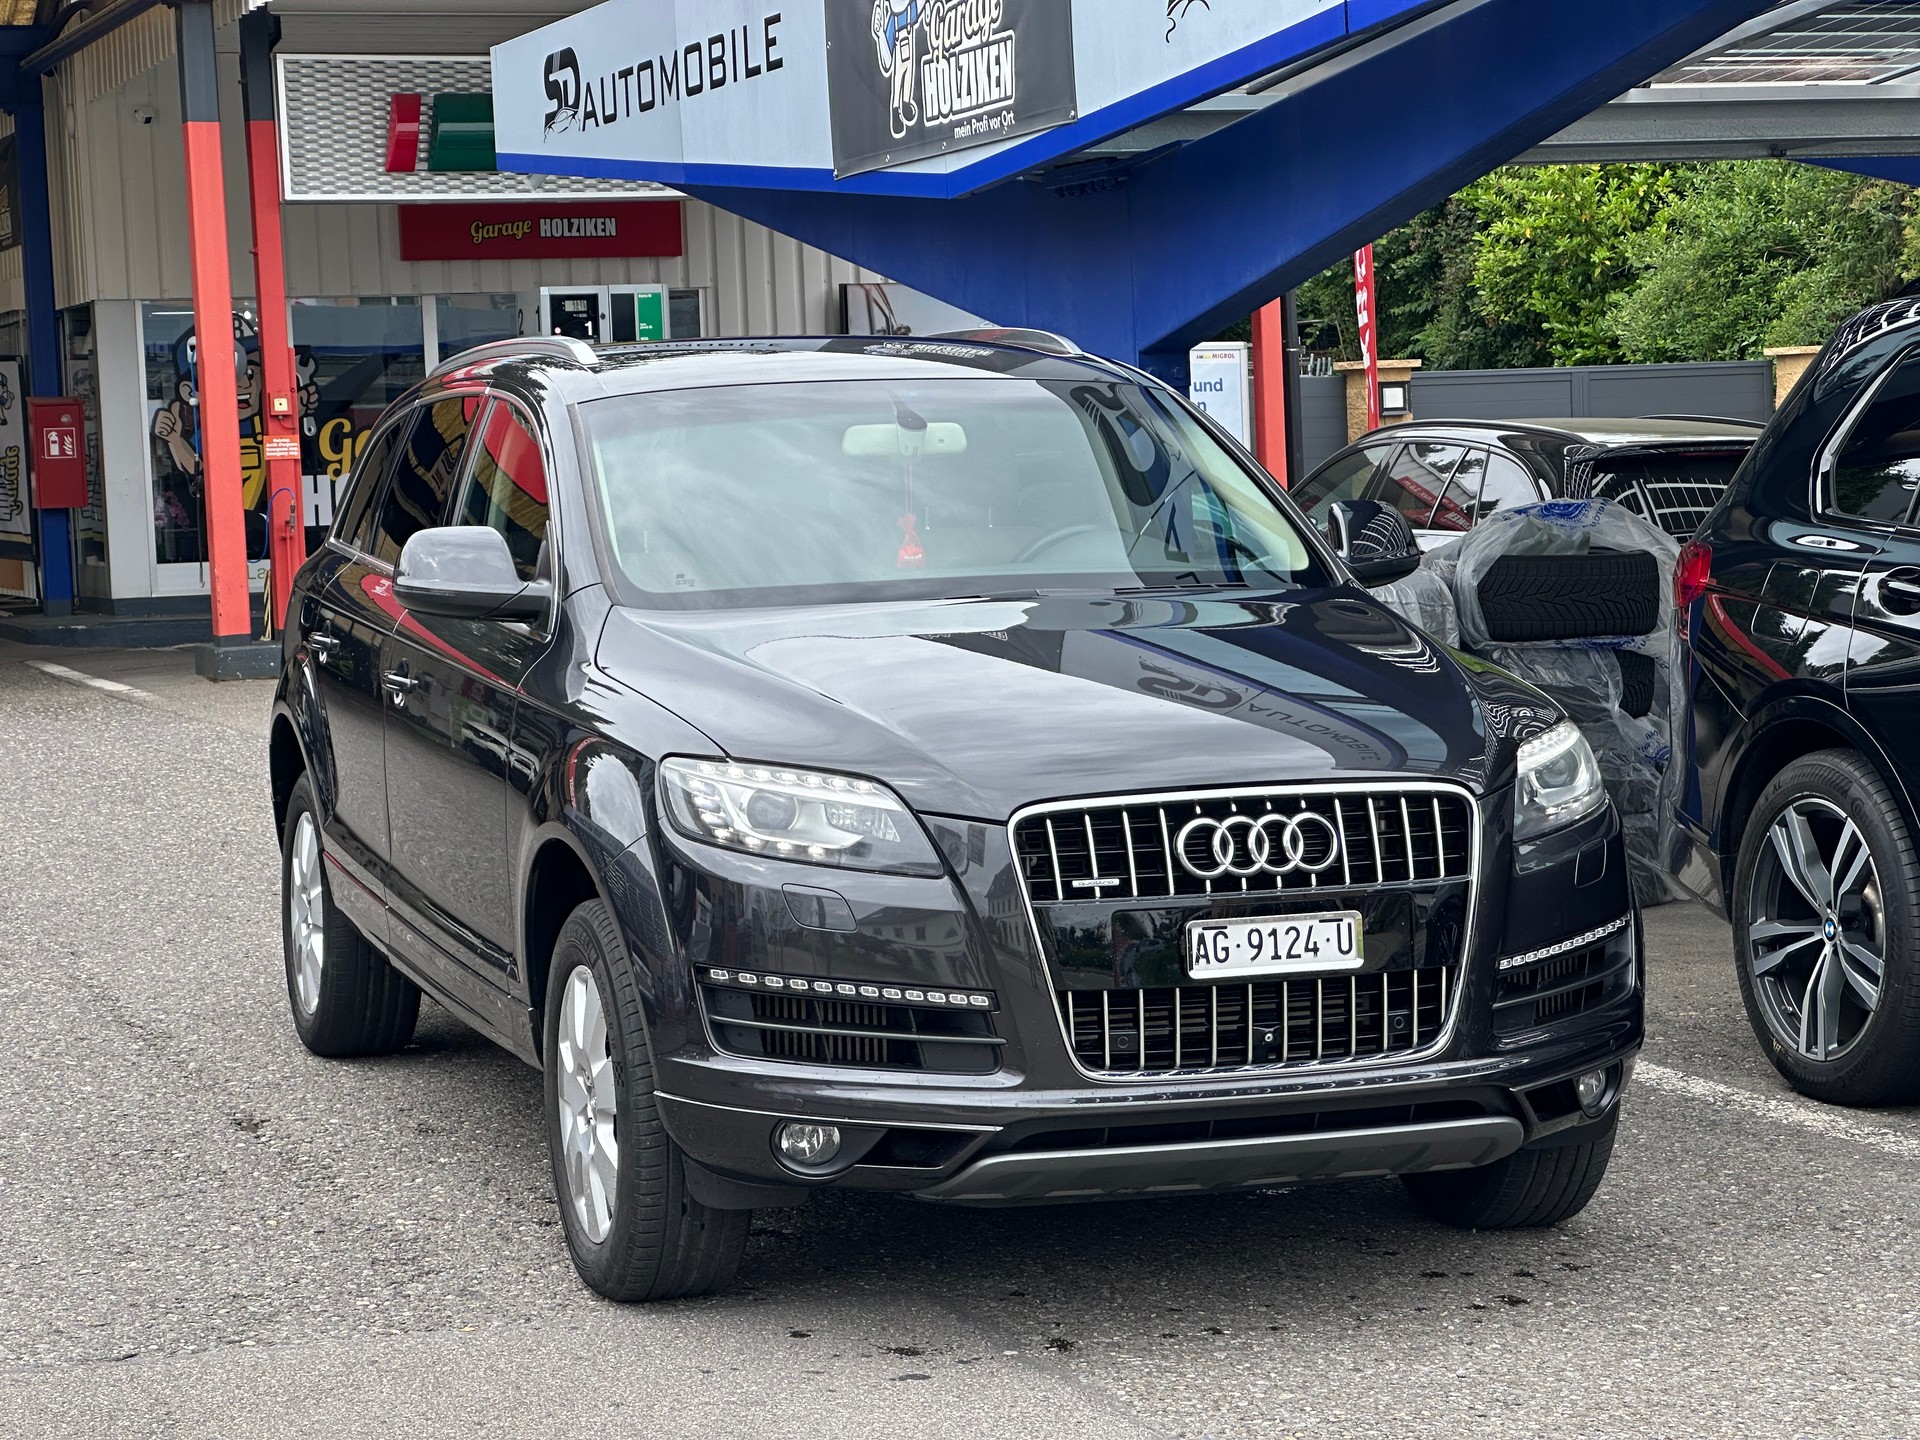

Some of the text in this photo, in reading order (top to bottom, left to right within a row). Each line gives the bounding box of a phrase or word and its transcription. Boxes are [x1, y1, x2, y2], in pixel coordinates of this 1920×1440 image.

[581, 13, 784, 132] AUTOMOBILE
[924, 40, 1013, 118] HOLZIKEN
[954, 110, 1015, 139] mein Profi vor Ort
[470, 218, 617, 244] Garage HOLZIKEN
[585, 321, 592, 336] 1
[1193, 378, 1223, 392] und
